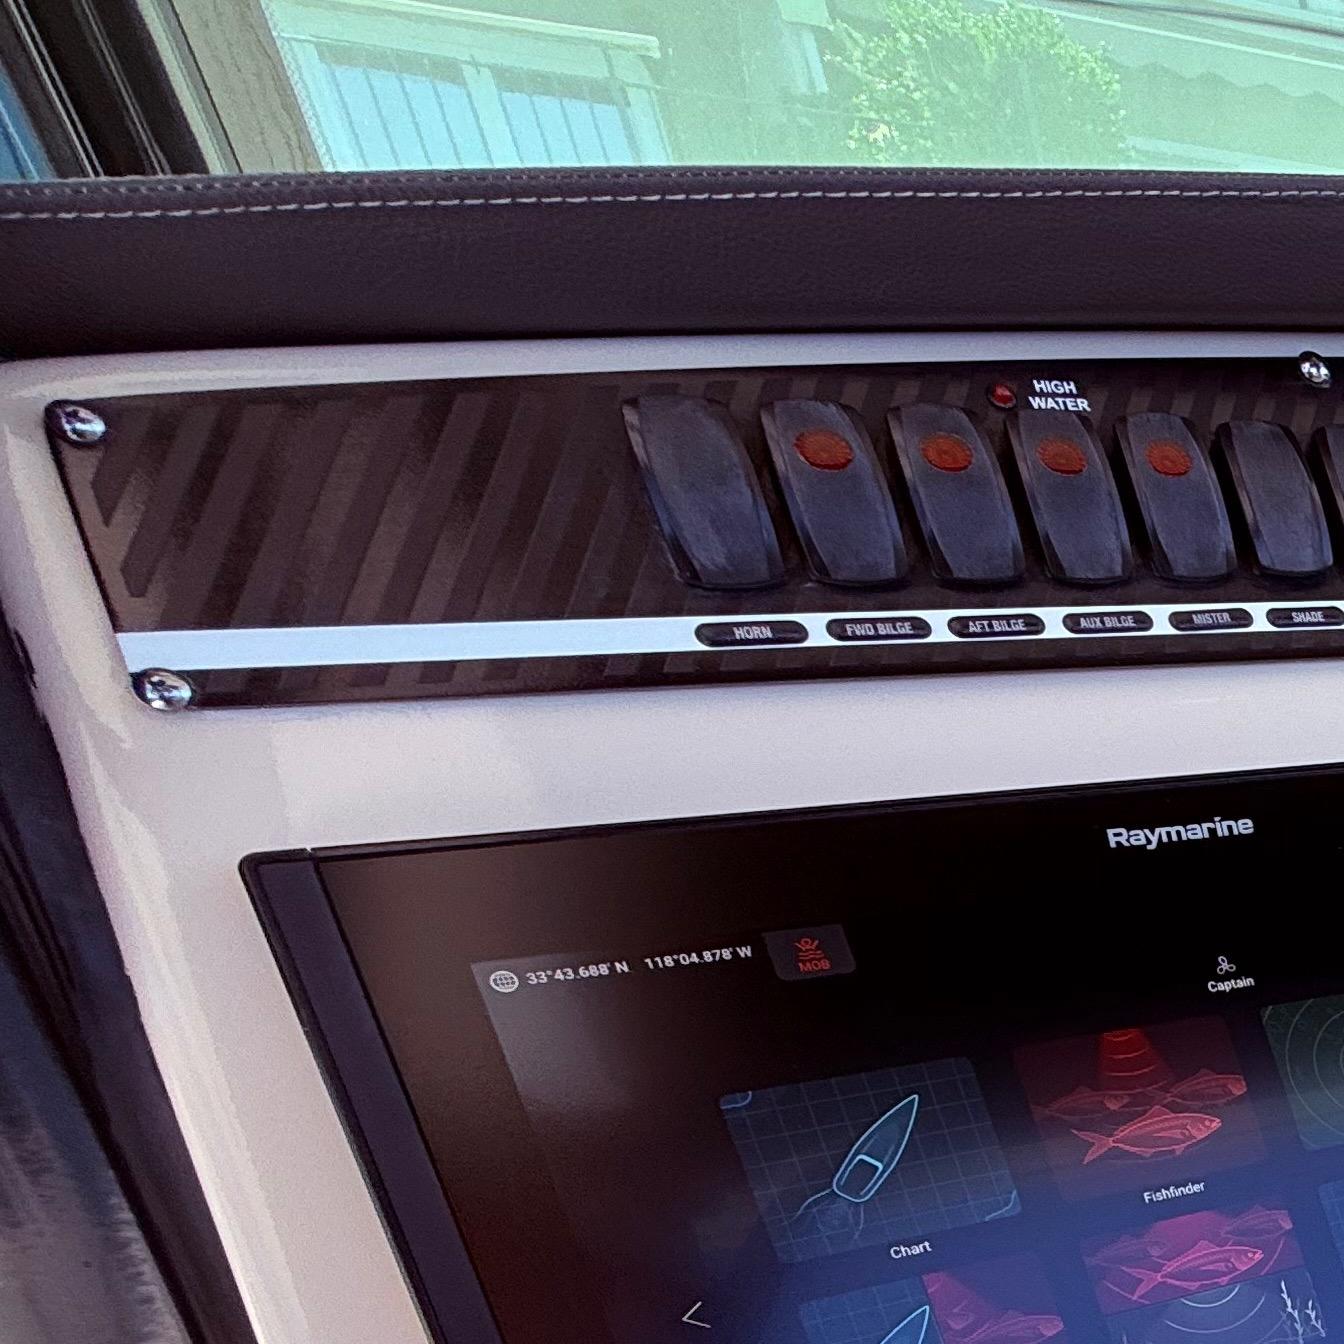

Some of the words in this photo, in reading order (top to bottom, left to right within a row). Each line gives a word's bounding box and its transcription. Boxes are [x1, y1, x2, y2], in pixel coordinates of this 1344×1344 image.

[1032, 379, 1078, 395] HIGH
[1028, 396, 1092, 412] WATER
[1079, 616, 1099, 628] AUX
[1101, 615, 1137, 628] BILGE
[1193, 612, 1232, 625] MISTER
[1292, 610, 1326, 623] SHADE
[733, 625, 773, 640] HORN
[845, 622, 875, 637] FWD
[876, 620, 915, 635] BILGE
[968, 619, 989, 632] AFT
[992, 618, 1026, 632] BILGE
[1106, 816, 1255, 850] Raymarine
[614, 961, 630, 974] N
[735, 945, 752, 958] W
[798, 959, 831, 972] MOB
[1207, 978, 1255, 993] Captain
[1143, 1181, 1206, 1204] Fishfinder
[889, 1240, 933, 1259] Chart
